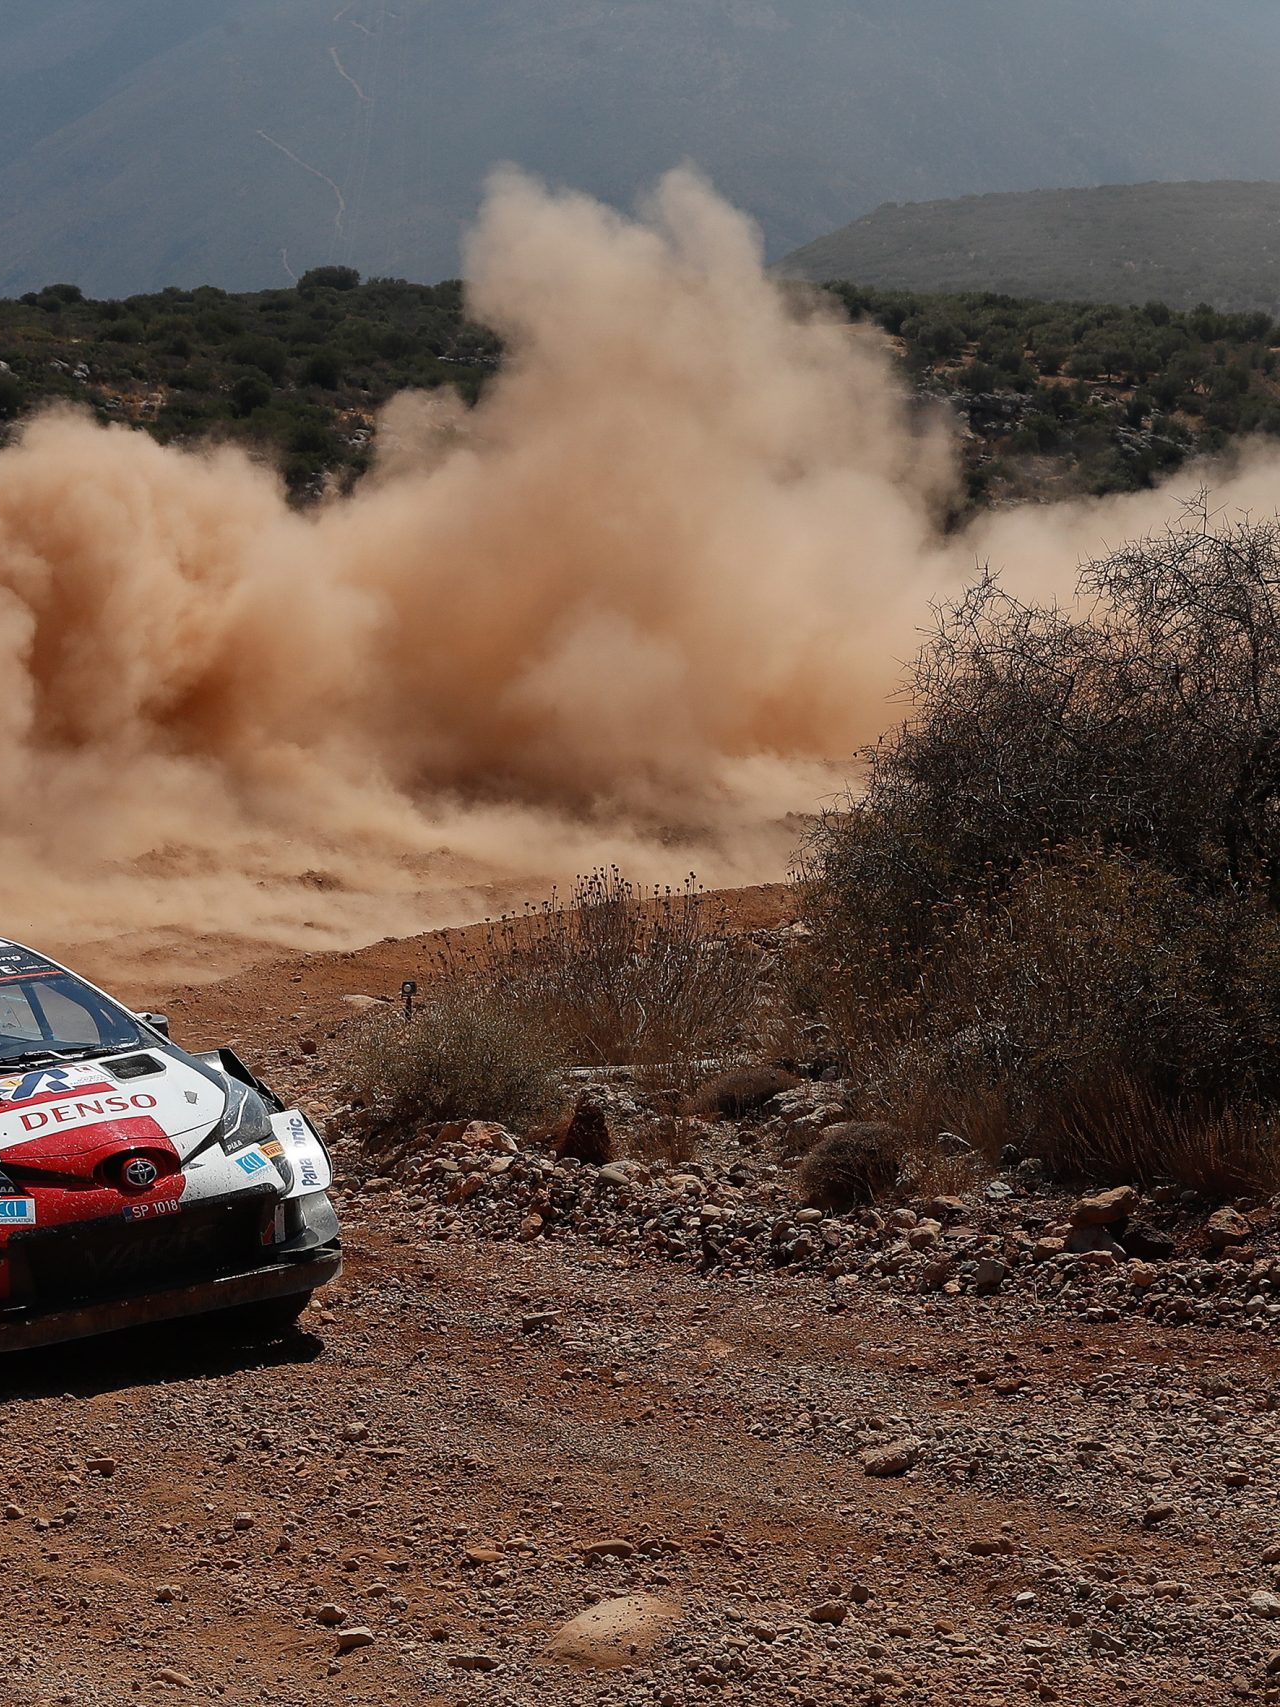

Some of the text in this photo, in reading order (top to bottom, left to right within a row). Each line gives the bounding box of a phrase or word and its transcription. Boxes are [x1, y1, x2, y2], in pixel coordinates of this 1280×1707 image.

[18, 1094, 157, 1131] DENSO
[227, 1139, 243, 1151] PIAA
[132, 1199, 179, 1219] SP 1018
